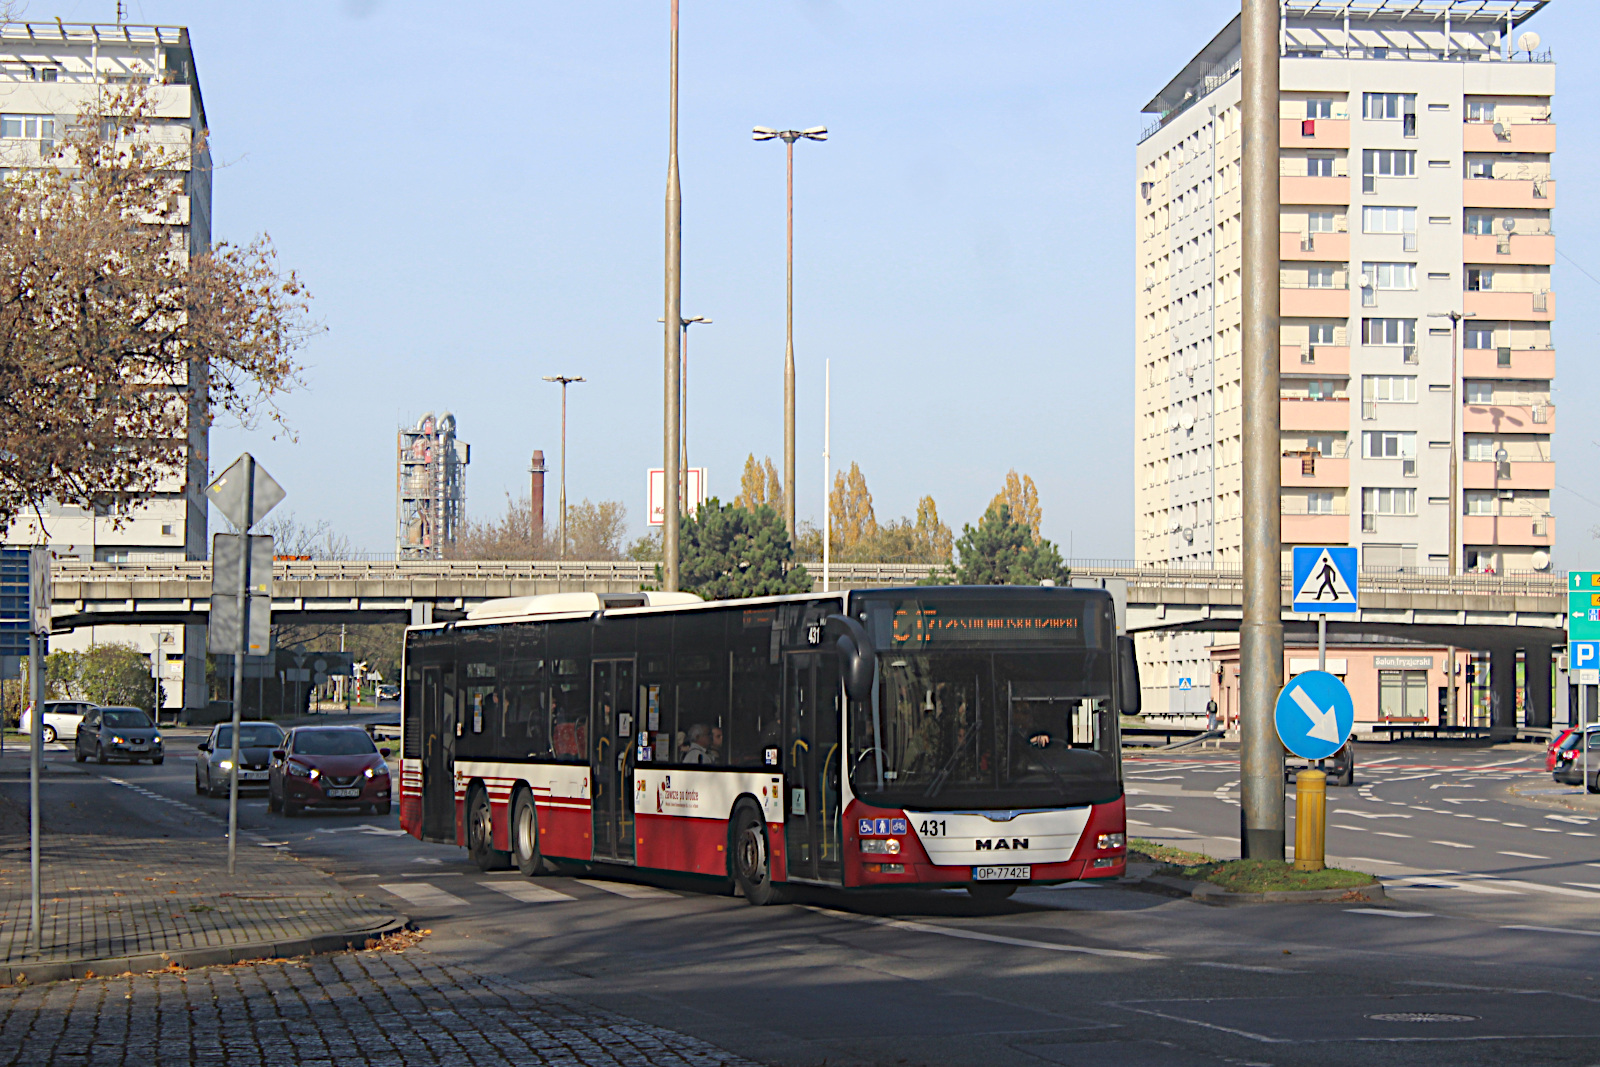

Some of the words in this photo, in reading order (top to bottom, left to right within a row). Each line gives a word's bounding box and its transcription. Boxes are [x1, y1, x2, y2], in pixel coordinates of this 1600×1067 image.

[808, 626, 820, 644] 431
[1577, 644, 1594, 667] P
[919, 820, 946, 836] 431
[975, 838, 1029, 851] MAN
